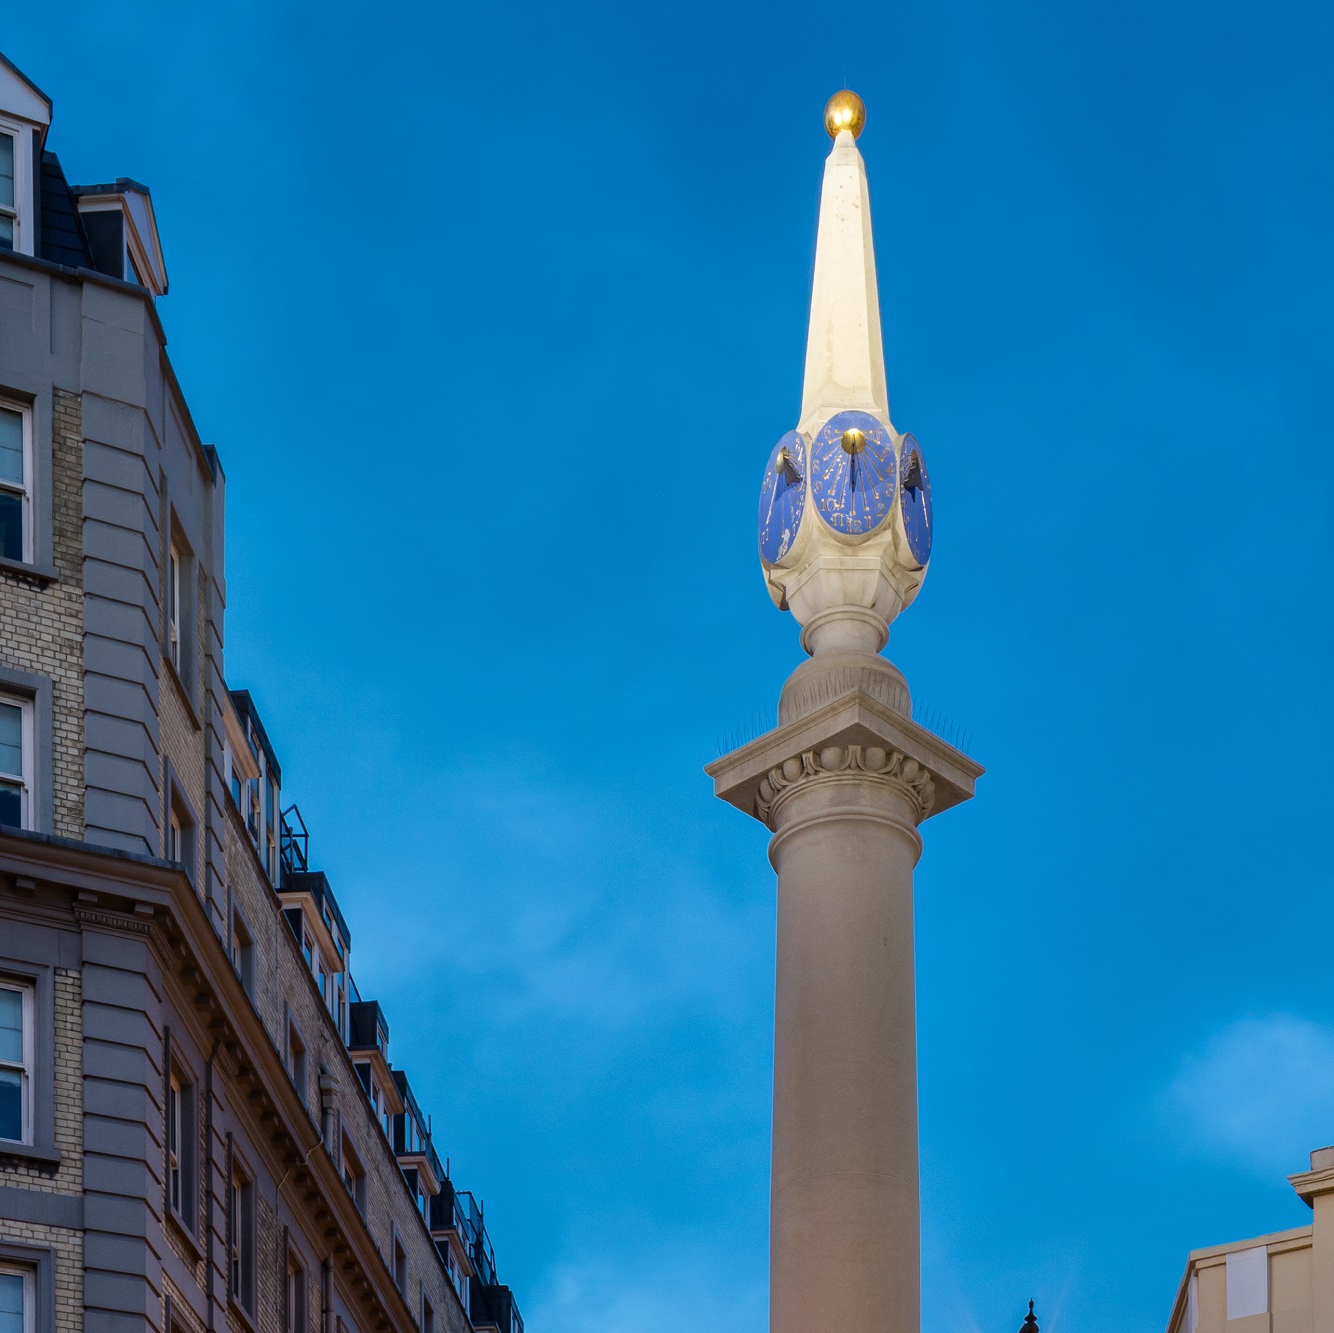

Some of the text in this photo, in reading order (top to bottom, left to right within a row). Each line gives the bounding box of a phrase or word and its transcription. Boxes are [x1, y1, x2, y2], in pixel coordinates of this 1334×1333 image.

[814, 442, 824, 456] 7
[882, 443, 891, 458] 5
[811, 460, 820, 474] 8
[885, 462, 895, 476] 4
[813, 480, 822, 494] 9
[885, 483, 894, 497] 3
[820, 498, 836, 512] 10
[876, 503, 885, 517] 2
[846, 519, 862, 533] 12
